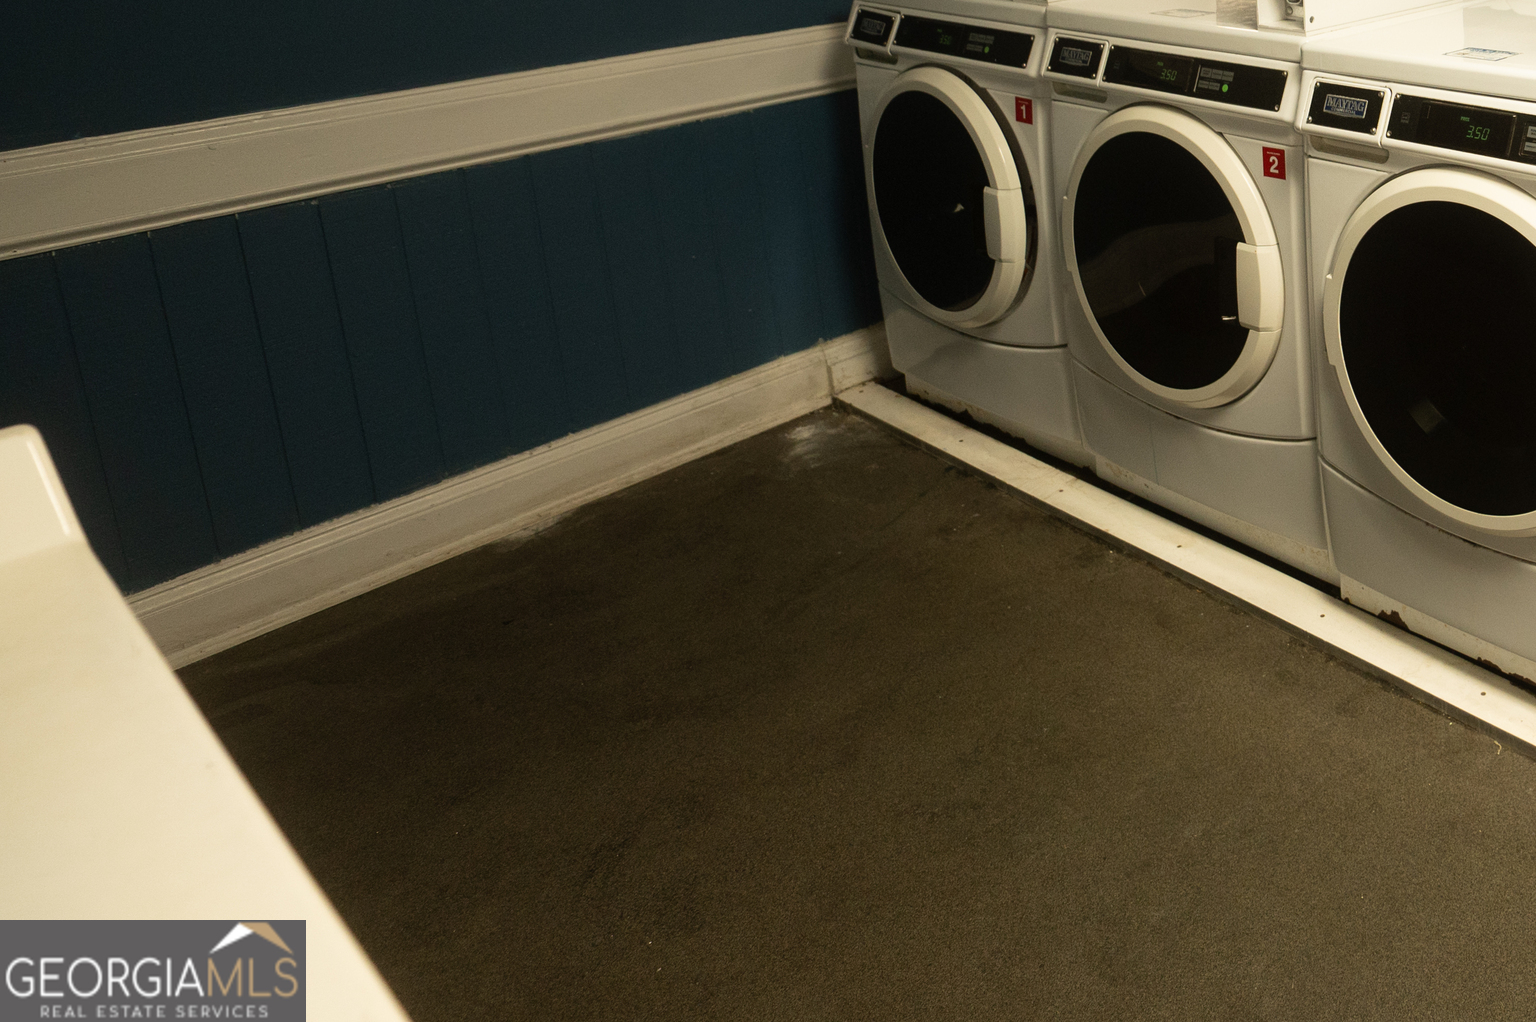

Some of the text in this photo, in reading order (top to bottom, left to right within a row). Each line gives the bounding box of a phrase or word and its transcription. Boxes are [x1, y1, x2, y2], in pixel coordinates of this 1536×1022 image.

[1062, 48, 1091, 61] MAYTAG
[1020, 104, 1027, 120] 1
[1327, 96, 1365, 112] MAYTAG
[1269, 155, 1279, 174] 2
